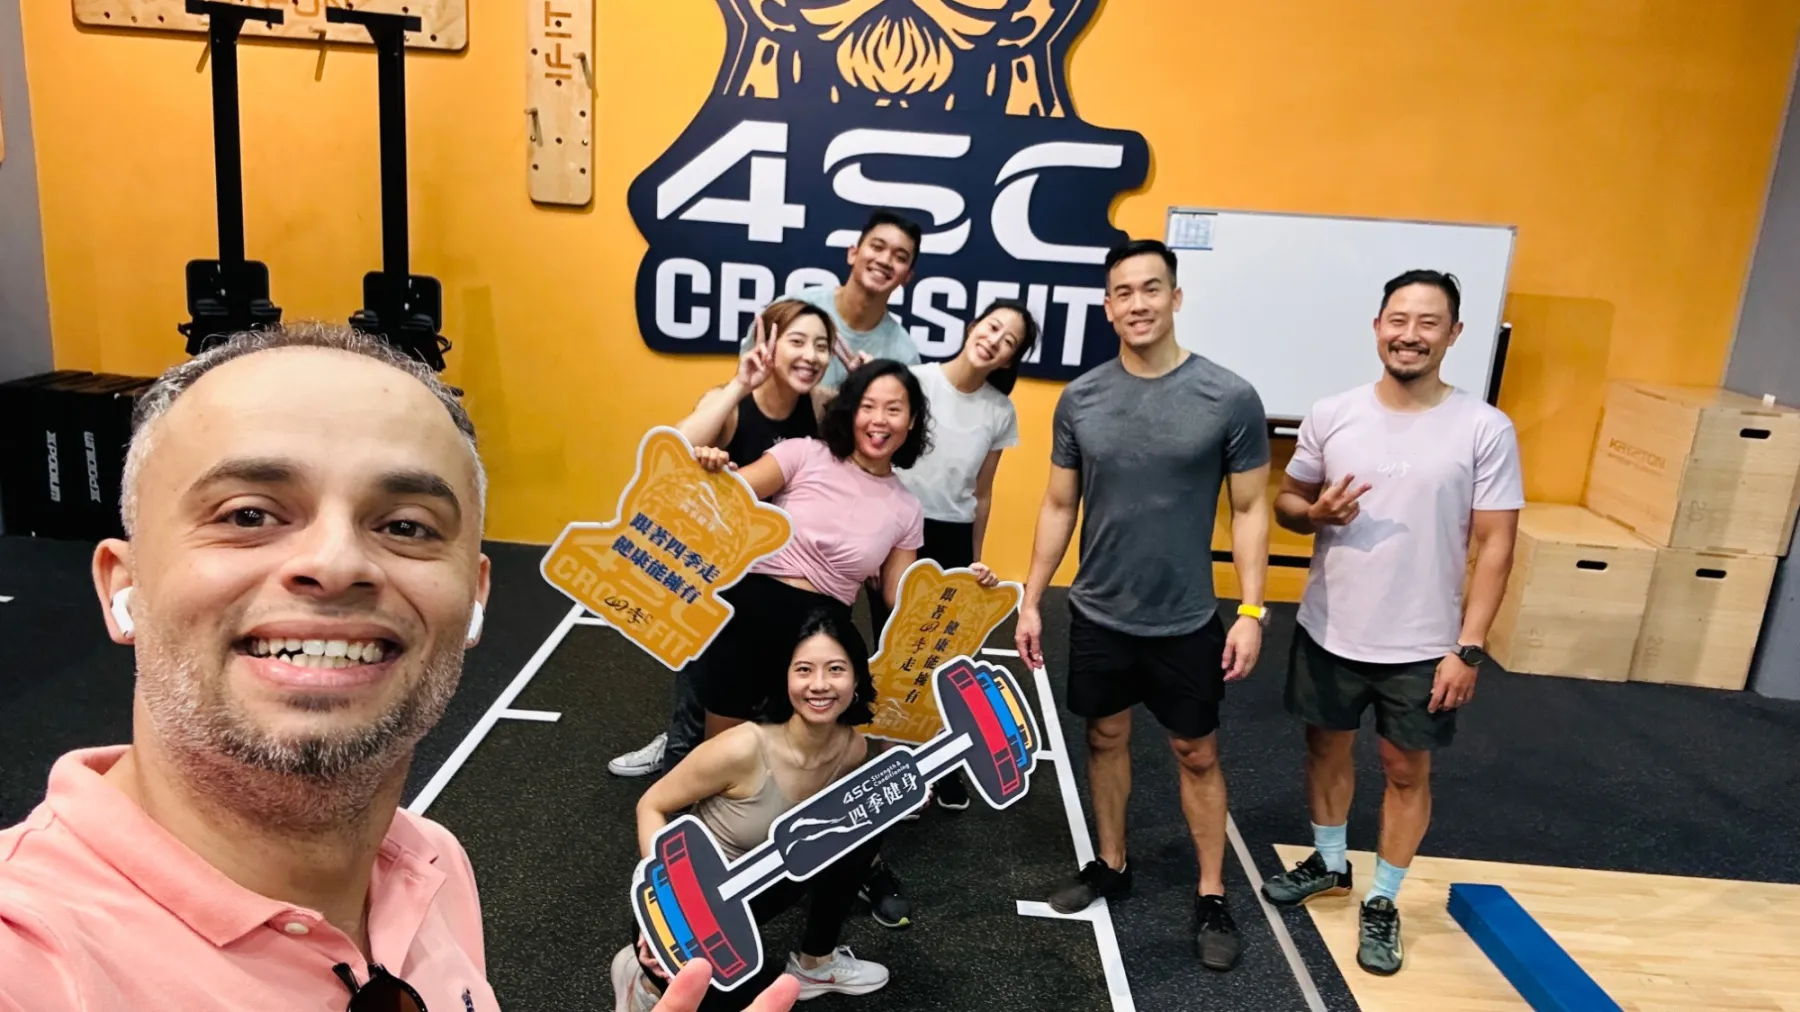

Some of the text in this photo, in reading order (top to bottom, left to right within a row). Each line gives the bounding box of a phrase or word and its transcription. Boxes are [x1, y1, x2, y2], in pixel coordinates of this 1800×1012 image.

[657, 120, 1123, 264] 4SC
[655, 258, 1105, 366] CRSIT
[870, 762, 896, 782] Strength
[873, 763, 911, 787] Conditioning
[842, 780, 874, 805] 4SC
[848, 772, 919, 826] 四季健身
